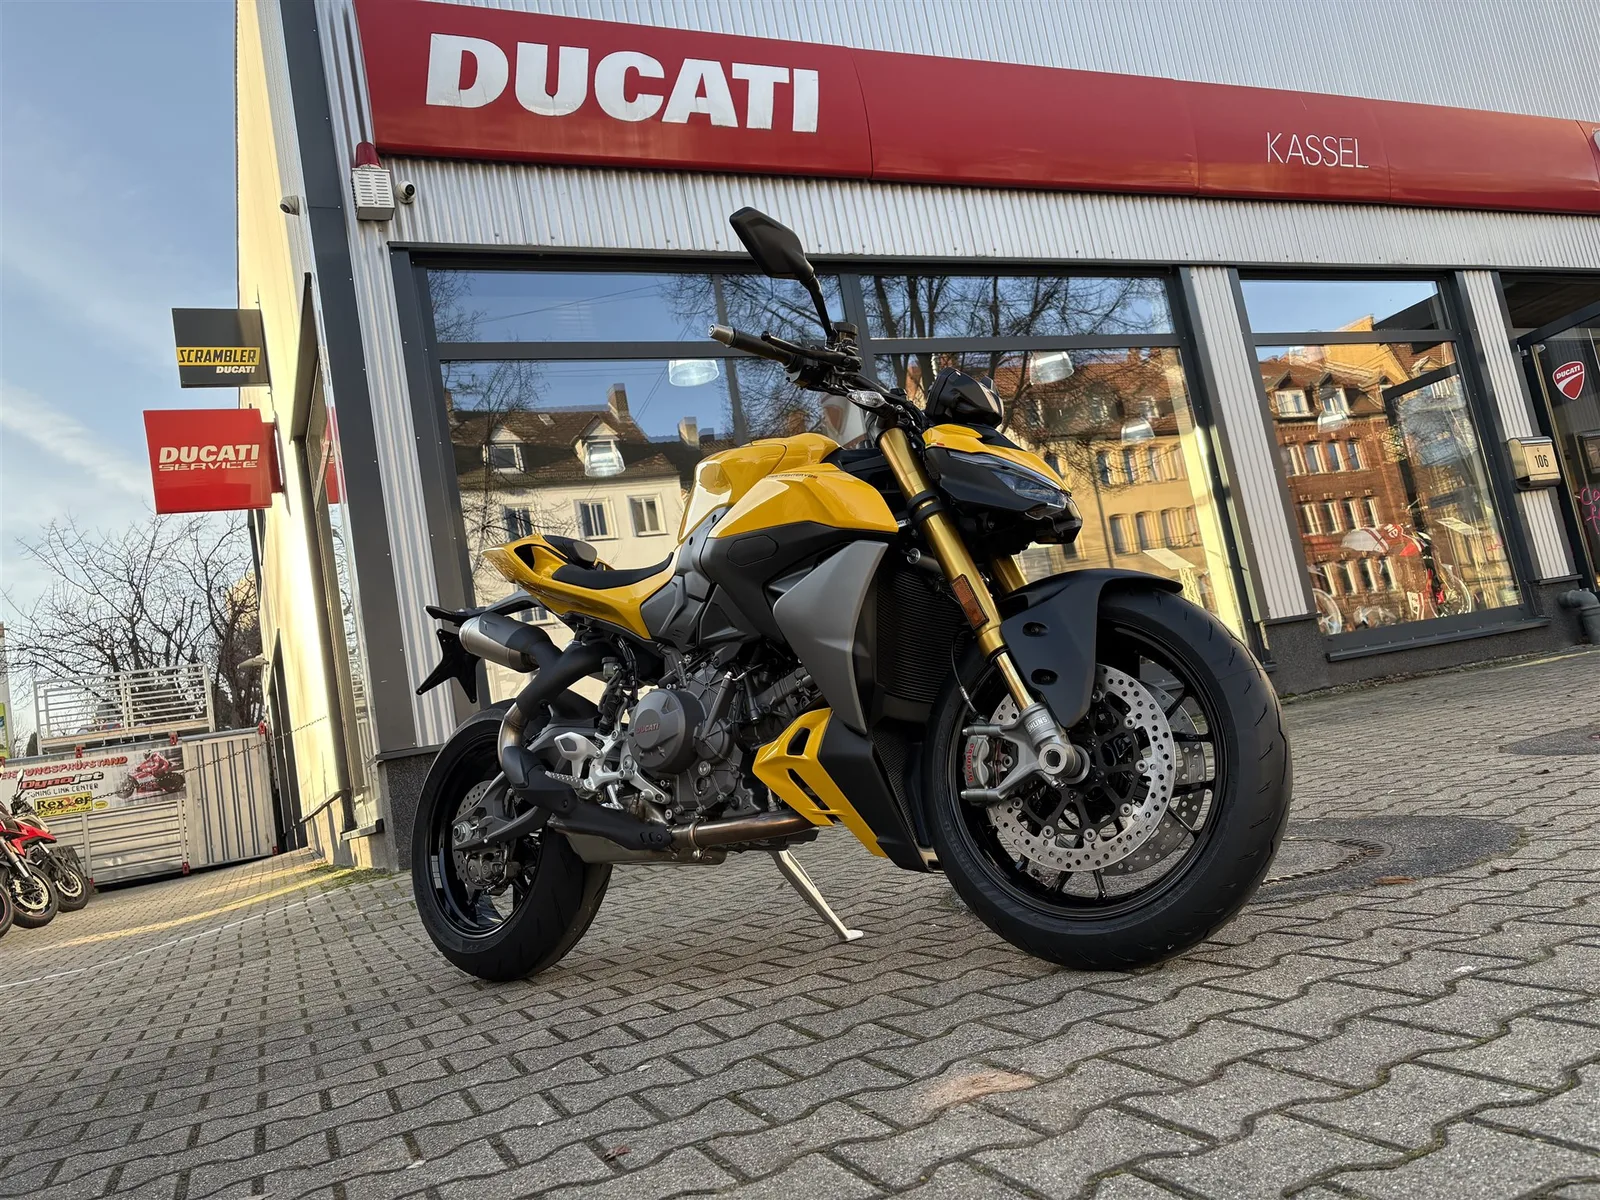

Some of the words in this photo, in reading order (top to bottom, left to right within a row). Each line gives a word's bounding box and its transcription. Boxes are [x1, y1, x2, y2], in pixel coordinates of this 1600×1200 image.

[426, 33, 819, 132] DUCATI
[1266, 131, 1369, 169] KASSEL
[178, 349, 256, 363] SCRAMBLER
[1556, 365, 1581, 379] DUCATI
[158, 444, 260, 464] DUCATI
[1534, 454, 1550, 468] 106
[158, 460, 257, 472] SERVICE
[636, 723, 659, 734] DUCATI
[0, 757, 128, 780] EISUNGSPRÜFSTAND
[966, 743, 975, 783] brembo
[20, 771, 104, 790] Dynojet
[53, 786, 70, 795] LINK
[71, 782, 99, 792] CENTER
